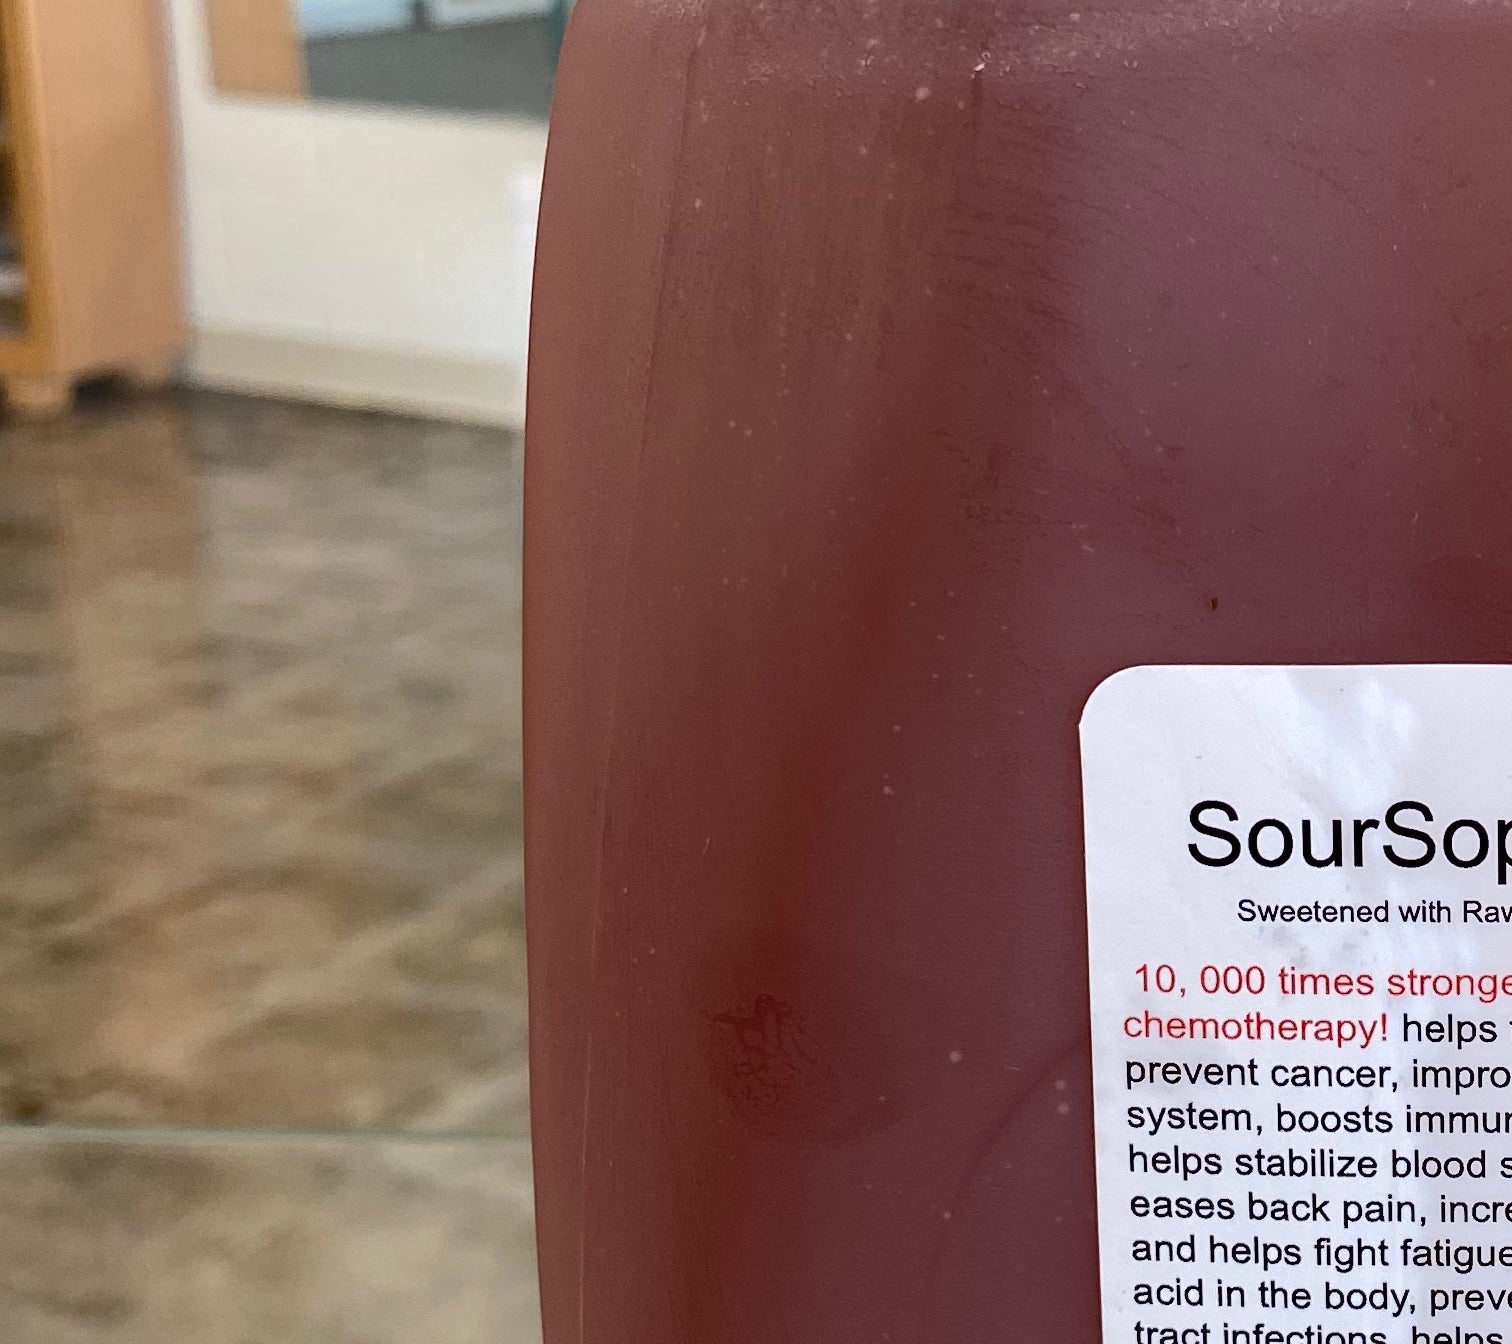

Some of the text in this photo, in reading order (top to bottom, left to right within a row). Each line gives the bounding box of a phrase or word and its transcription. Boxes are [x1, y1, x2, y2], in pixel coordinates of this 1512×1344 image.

[1236, 898, 1390, 924] Sweetened
[1397, 898, 1452, 924] with
[1135, 962, 1187, 999] 10,
[1199, 964, 1266, 996] 000
[1277, 965, 1375, 997] times
[1123, 1008, 1388, 1051] chemotherapy!
[1402, 1012, 1499, 1051] helps
[1125, 1057, 1260, 1091] prevent
[1270, 1063, 1398, 1094] cancer,
[1126, 1100, 1263, 1137] system,
[1276, 1102, 1394, 1134] boosts
[1128, 1142, 1223, 1182] helps
[1234, 1147, 1378, 1179] stabilize
[1391, 1148, 1487, 1180] blood
[1129, 1194, 1236, 1221] eases
[1247, 1190, 1332, 1224] back
[1342, 1192, 1427, 1230] pain,
[1131, 1232, 1196, 1264] and
[1208, 1233, 1303, 1273] helps
[1312, 1236, 1390, 1275] fight
[1132, 1276, 1205, 1307] acid
[1216, 1277, 1246, 1308] in
[1257, 1278, 1312, 1311] the
[1324, 1280, 1416, 1319] body,
